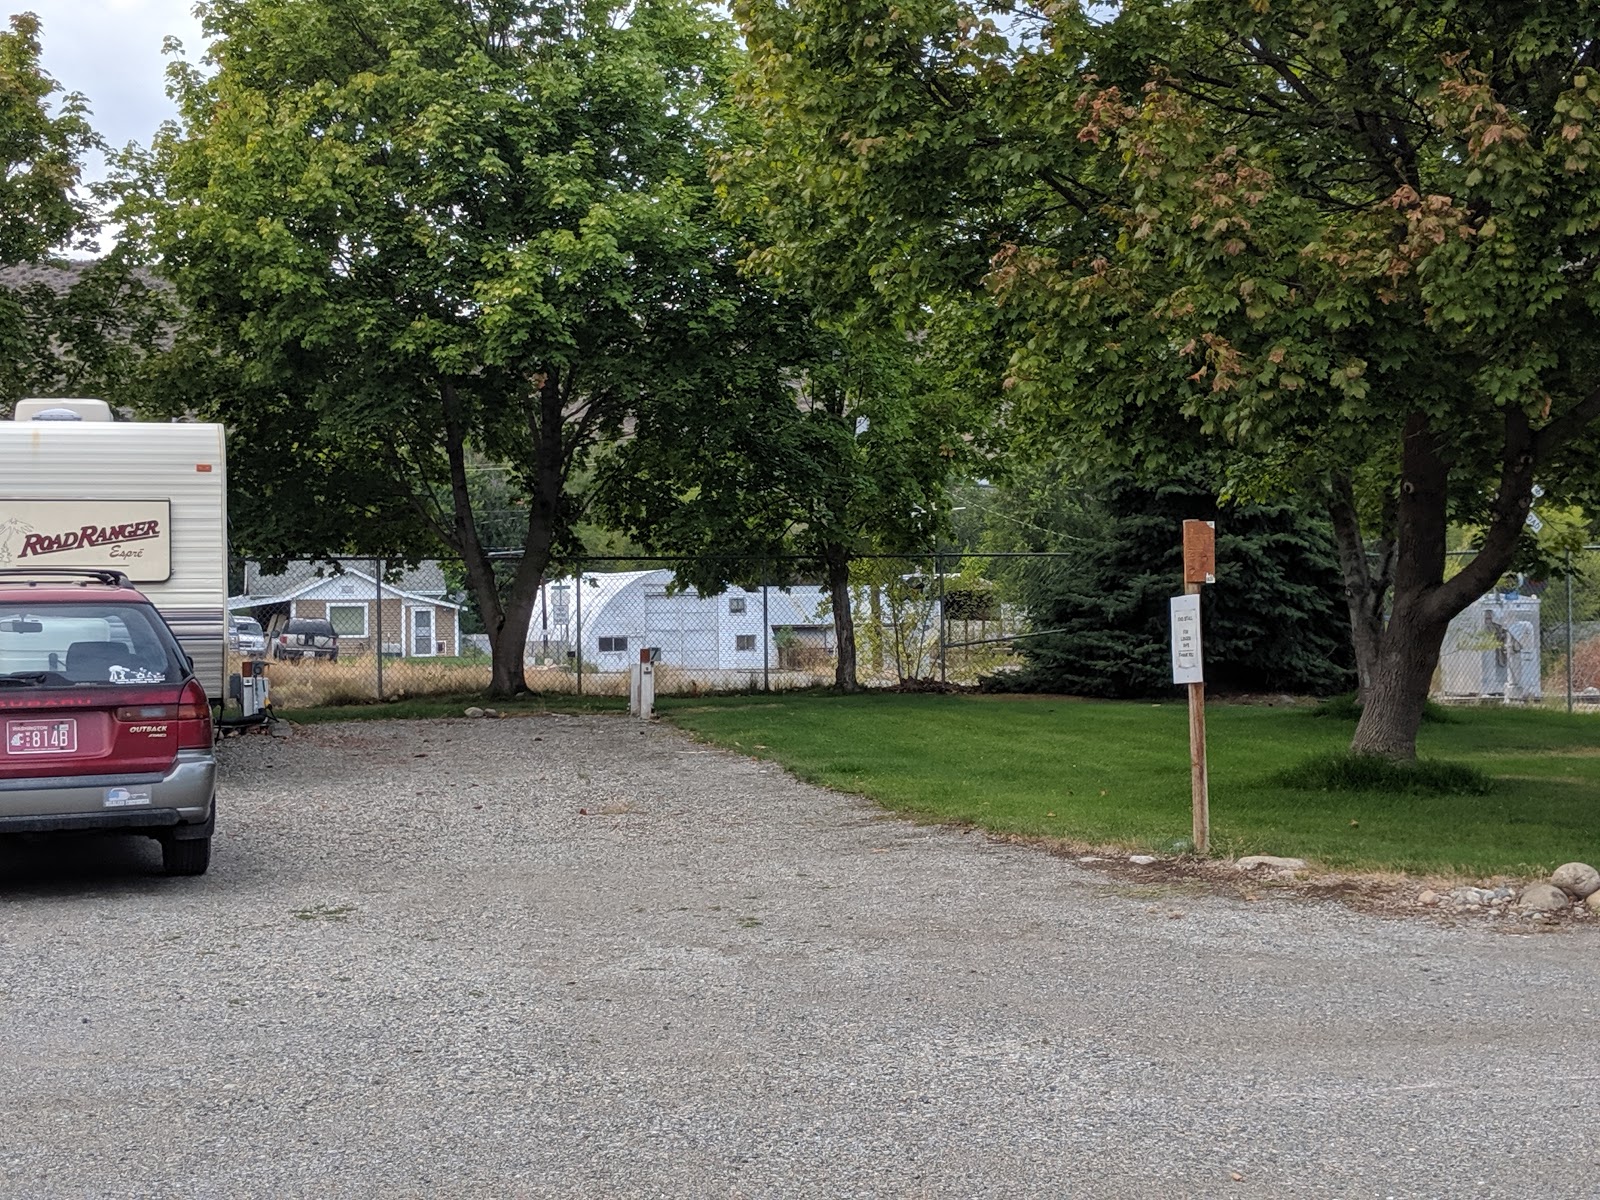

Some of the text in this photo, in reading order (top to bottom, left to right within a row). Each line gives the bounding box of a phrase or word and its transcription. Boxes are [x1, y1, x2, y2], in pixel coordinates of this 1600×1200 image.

[651, 647, 659, 660] 7
[253, 663, 262, 675] 6
[129, 725, 168, 733] OUTBACK
[32, 730, 68, 747] 814B
